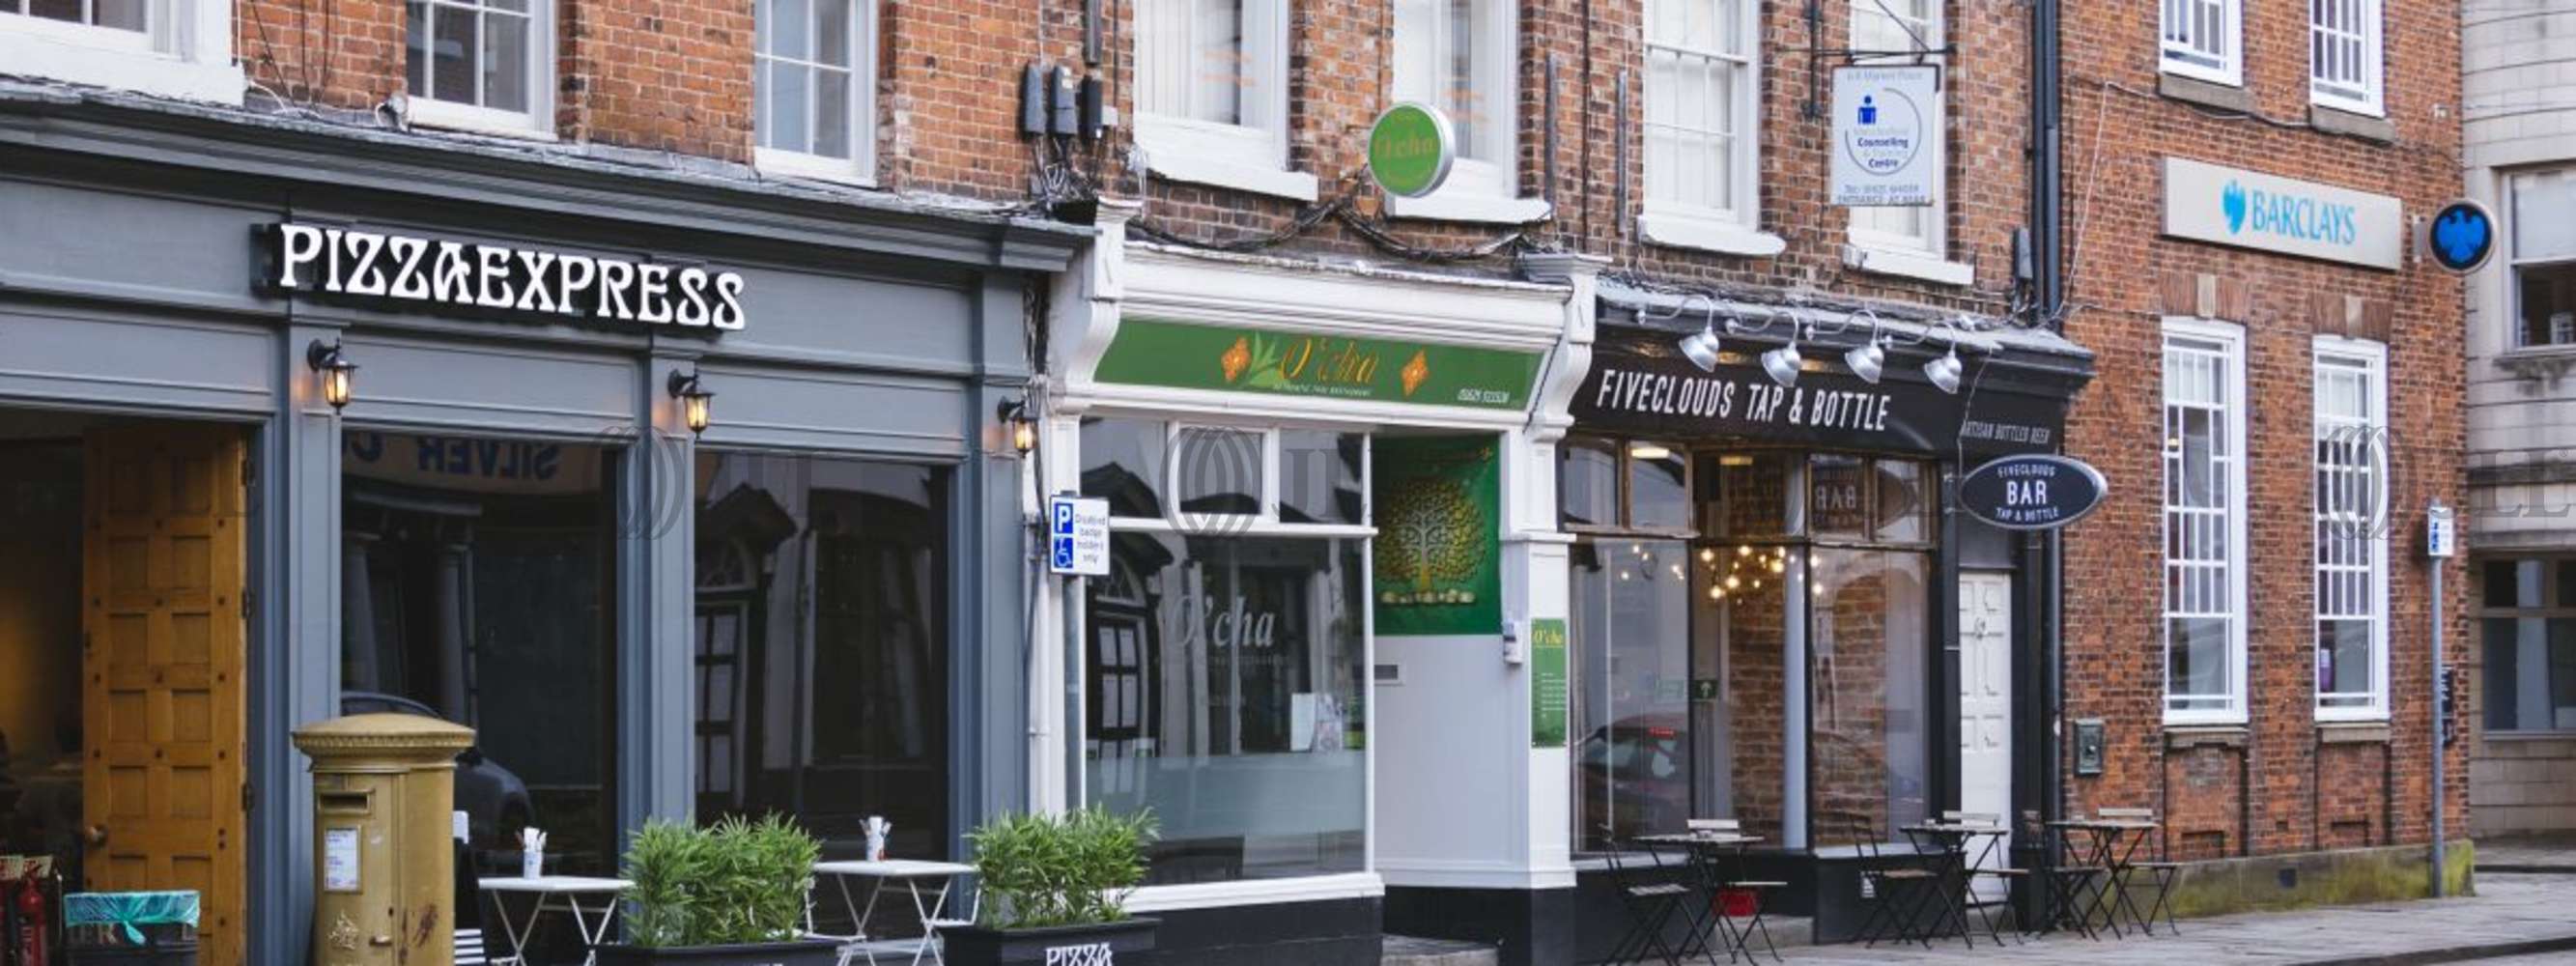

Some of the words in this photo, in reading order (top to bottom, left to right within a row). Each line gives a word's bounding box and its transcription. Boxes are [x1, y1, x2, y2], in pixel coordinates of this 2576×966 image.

[1857, 137, 1909, 149] Counselling
[2251, 189, 2357, 245] BARCLAYS
[279, 223, 747, 331] PIZZAEXPRESS
[1596, 369, 1735, 418] FIVECLOUDS
[1745, 384, 1784, 422] TAP
[1788, 387, 1803, 425] &
[1810, 388, 1891, 431] BOTTLE
[1996, 464, 2057, 478] FIVECLOUDS
[2006, 480, 2048, 505] BAR
[1058, 505, 1071, 532] P
[1996, 506, 2013, 520] TAP
[2024, 506, 2060, 523] BOTTLE
[1173, 593, 1276, 648] O'cha
[1046, 942, 1113, 966] PIZZA
